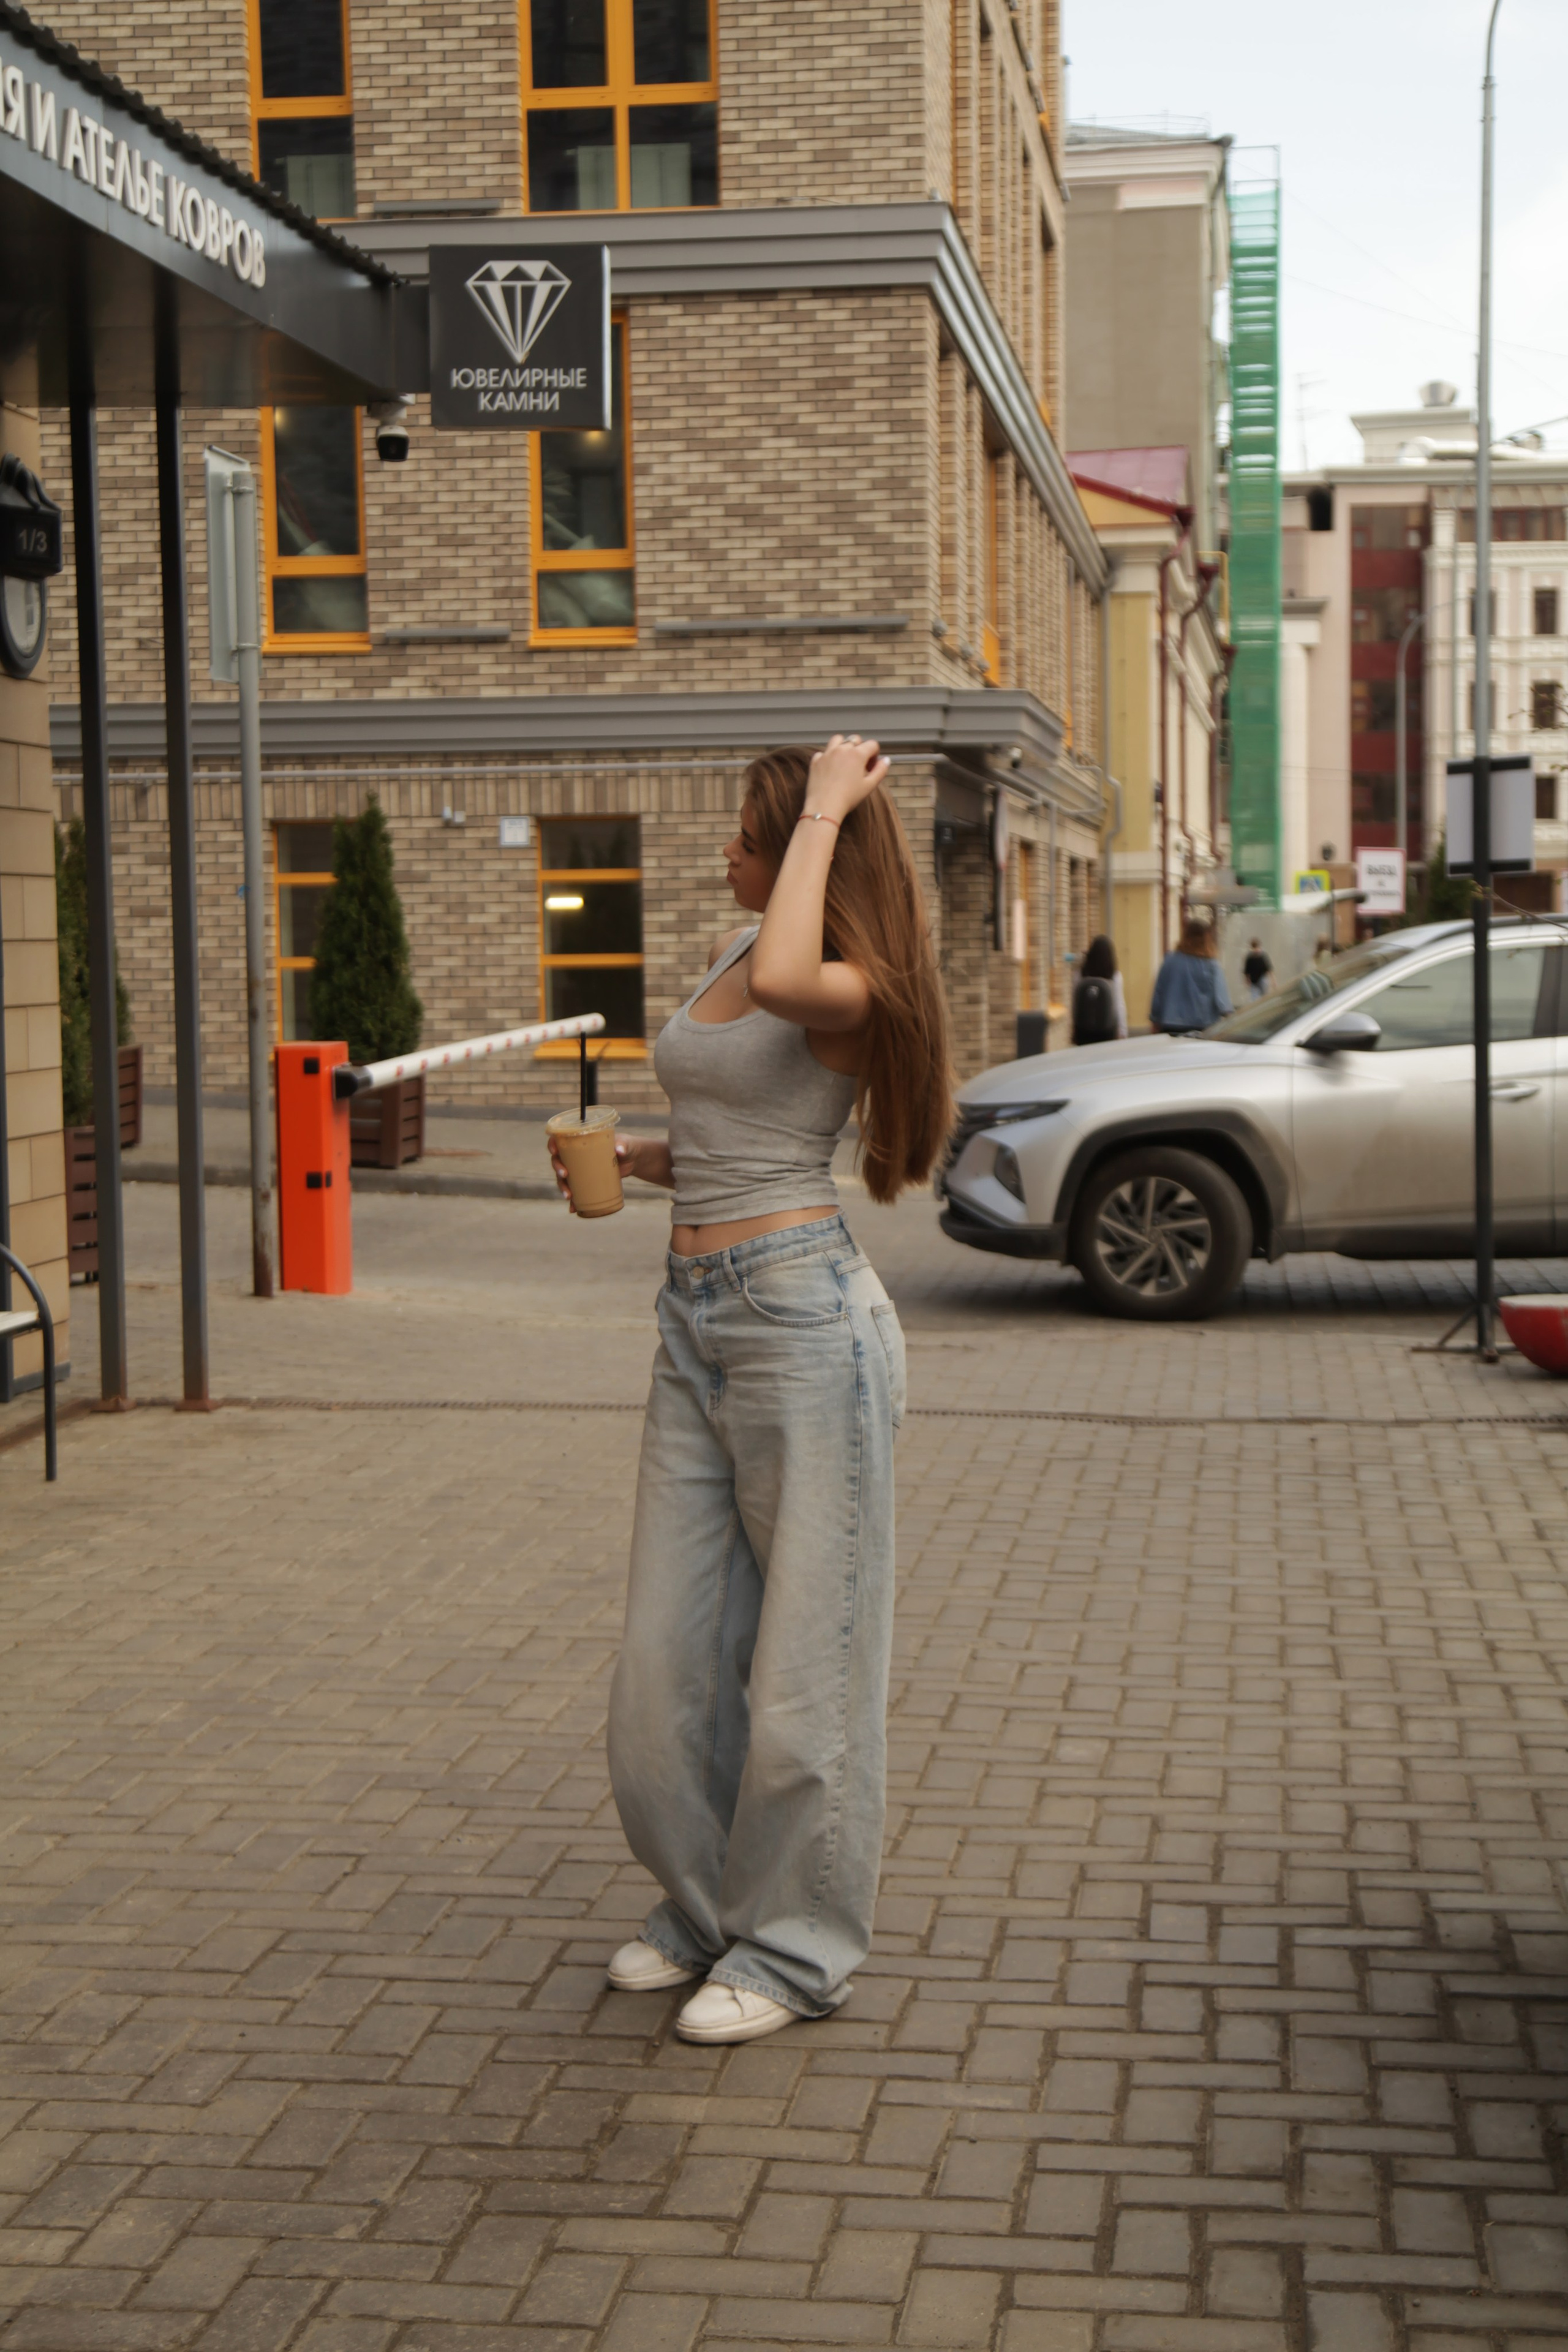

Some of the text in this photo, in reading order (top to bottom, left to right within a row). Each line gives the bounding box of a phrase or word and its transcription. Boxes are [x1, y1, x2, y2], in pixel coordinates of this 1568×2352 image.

[0, 56, 266, 288] Я И АТЕЛЬЕ КОВРОВ
[451, 368, 587, 389] ЮВЕЛИРНЫЕ
[479, 391, 560, 412] КАМНИ
[18, 529, 48, 552] 1/3
